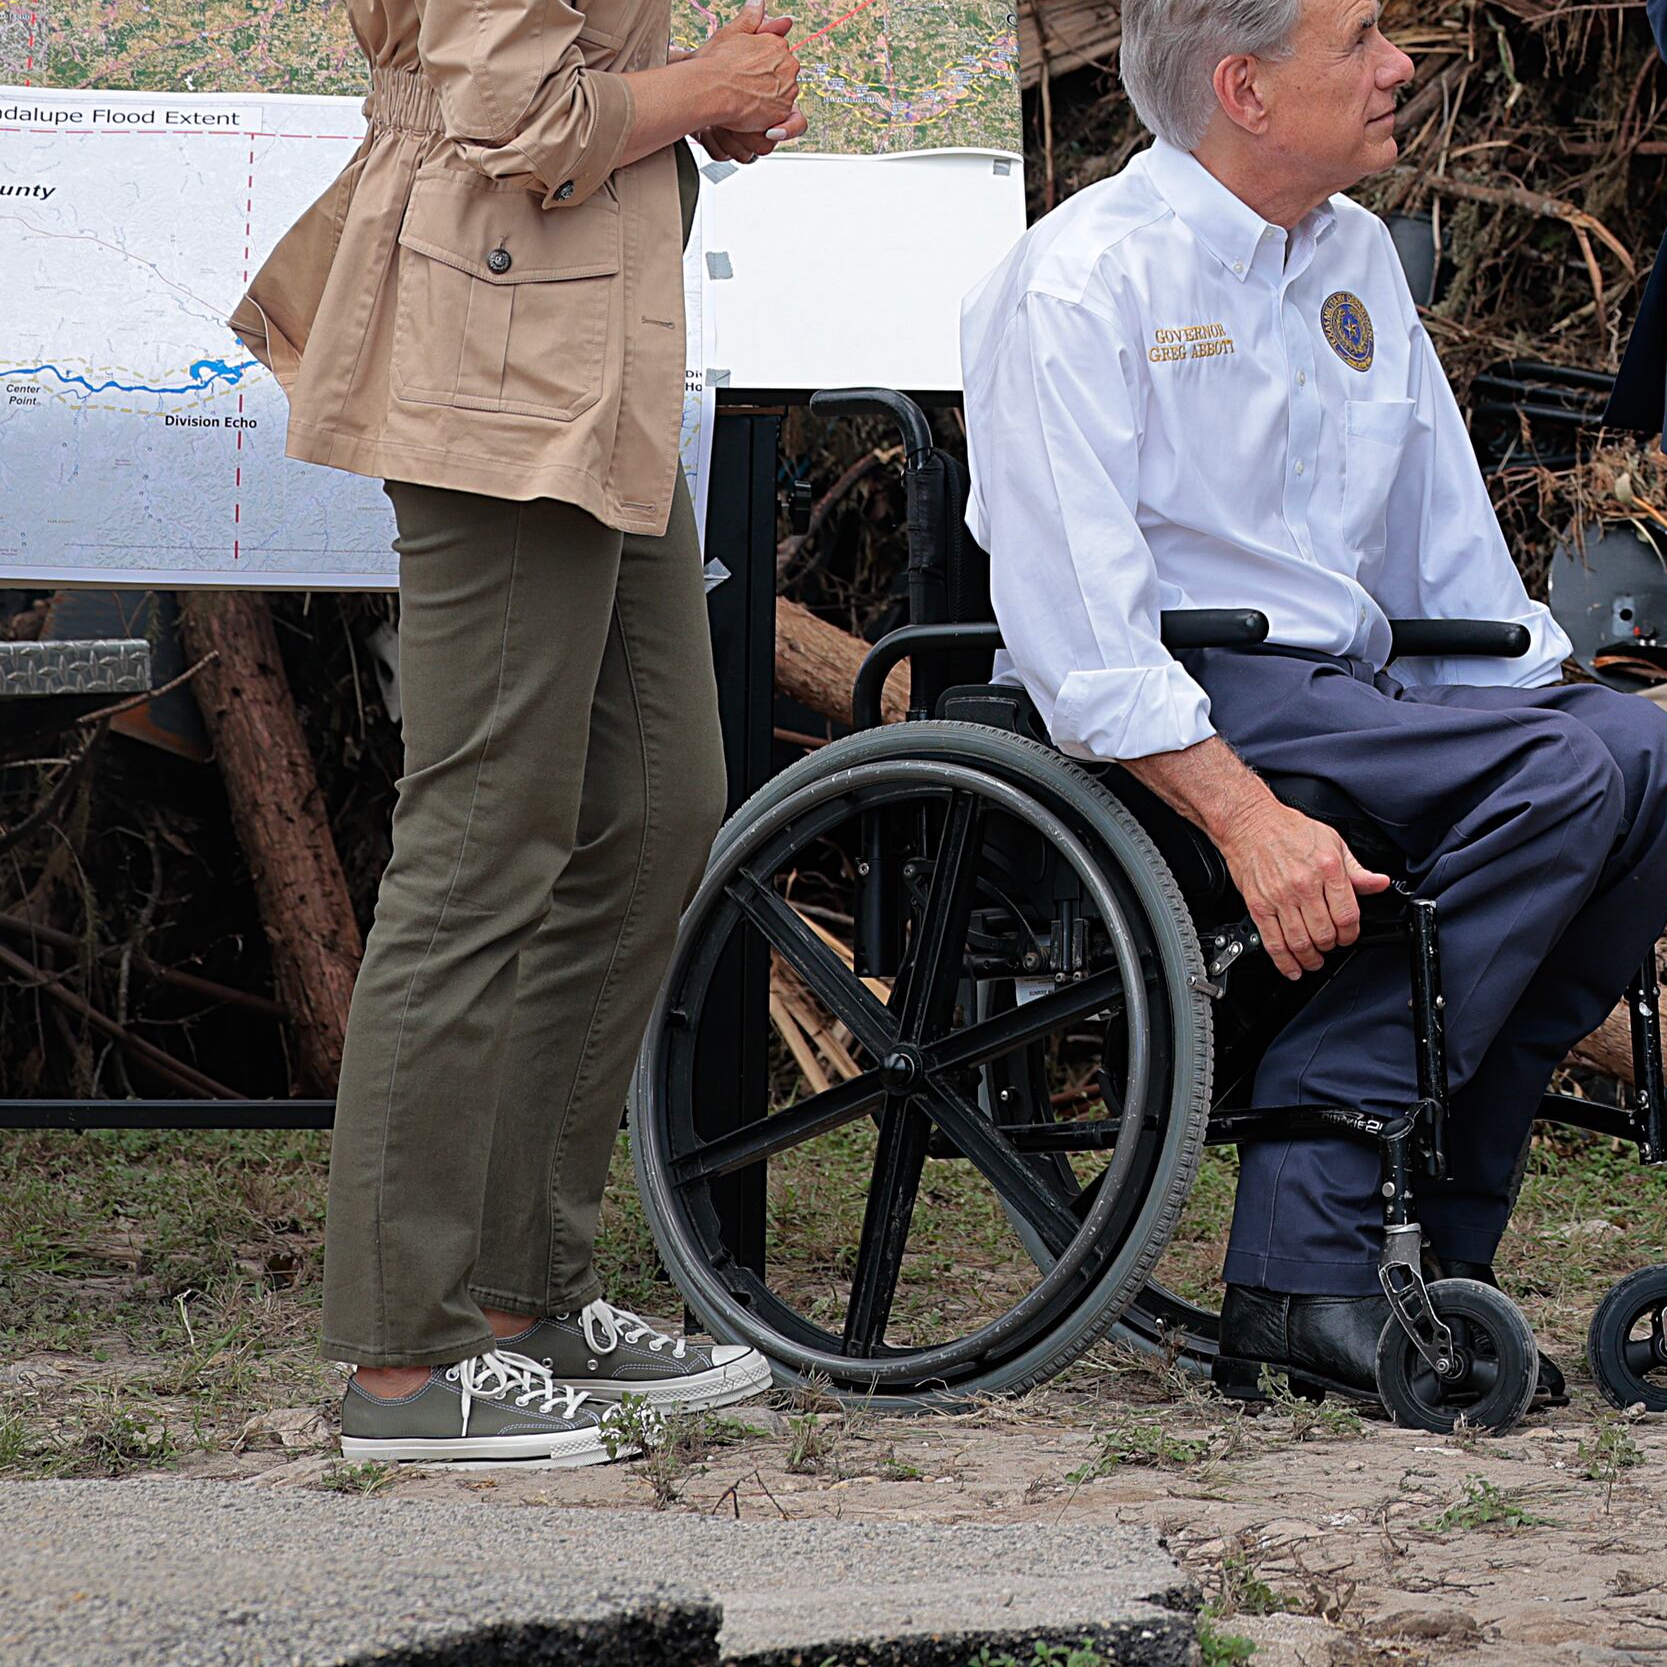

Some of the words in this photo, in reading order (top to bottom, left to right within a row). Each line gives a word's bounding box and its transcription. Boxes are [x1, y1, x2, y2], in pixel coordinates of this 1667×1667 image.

[0, 106, 83, 125] dalupe
[93, 109, 155, 124] Flood
[165, 111, 240, 126] Extent
[0, 183, 56, 201] unty
[1155, 321, 1227, 344] GOVERNOR
[1148, 343, 1187, 362] GREG
[1191, 338, 1235, 359] ABBOTT
[6, 383, 41, 394] Center
[9, 395, 37, 406] Point
[165, 414, 220, 428] Division
[224, 416, 258, 429] Echo
